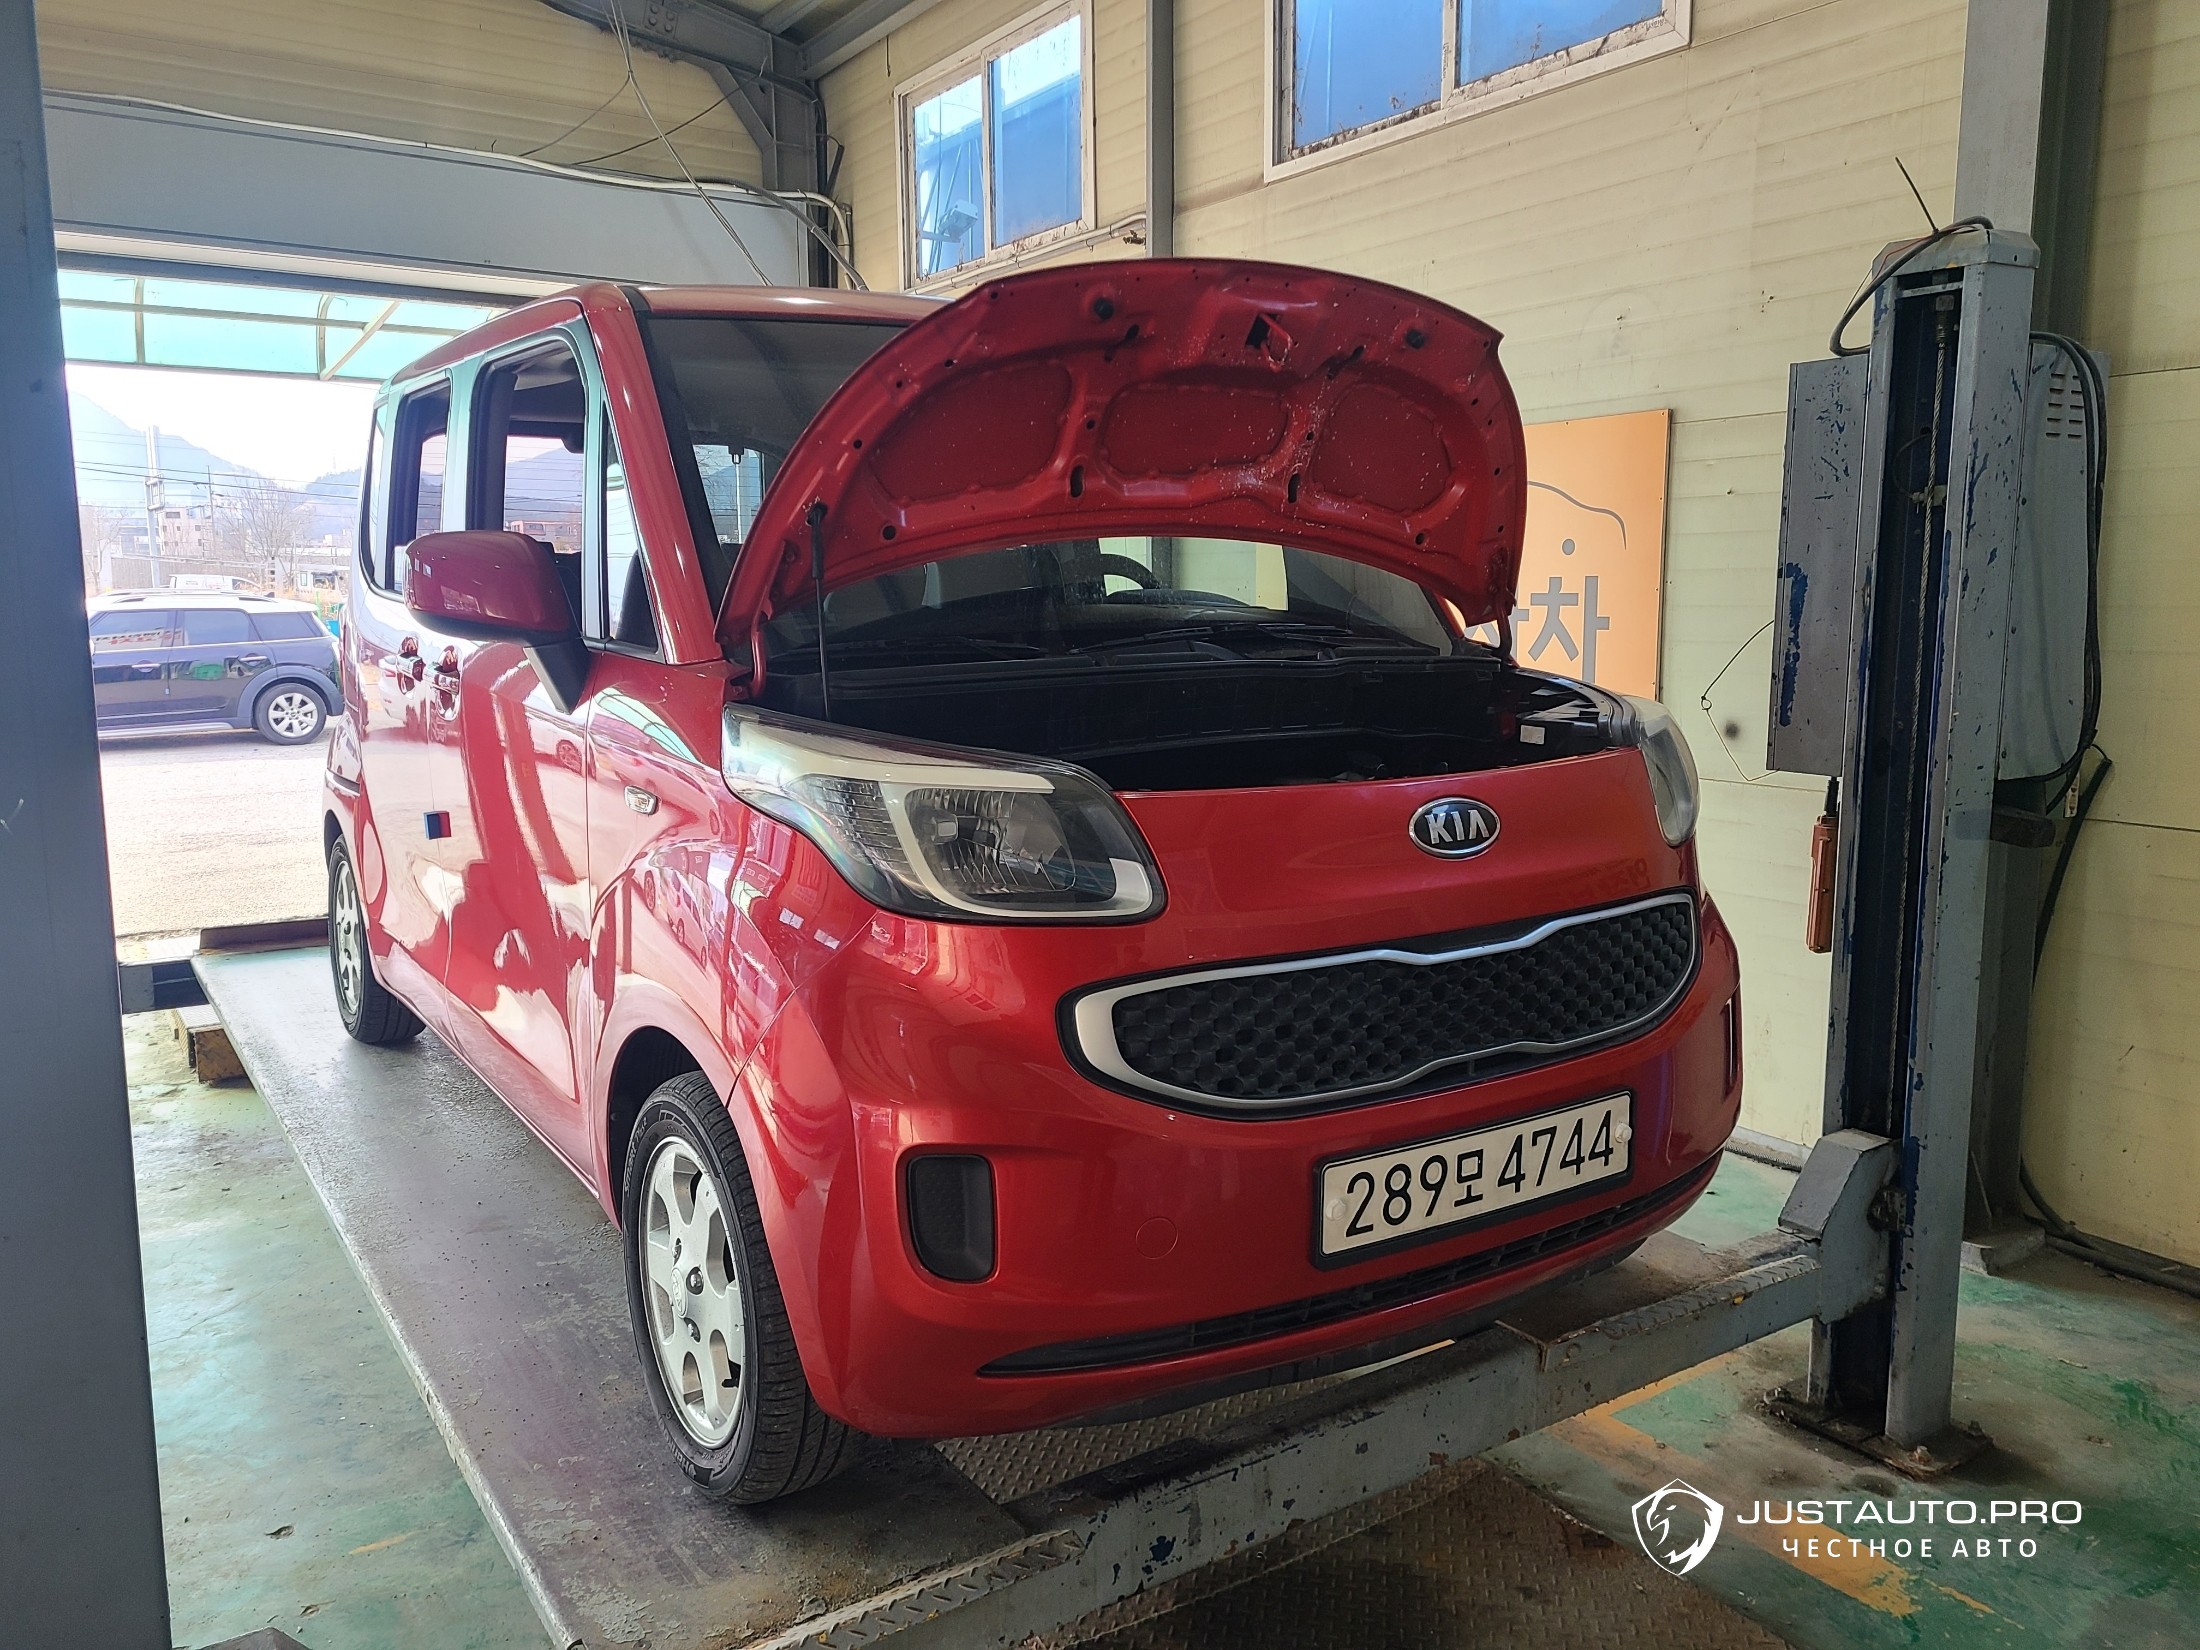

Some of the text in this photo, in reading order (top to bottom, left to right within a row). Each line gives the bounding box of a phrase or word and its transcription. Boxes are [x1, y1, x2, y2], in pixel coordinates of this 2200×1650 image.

[1425, 809, 1490, 844] KIA
[1345, 1110, 1614, 1238] 289모 4744
